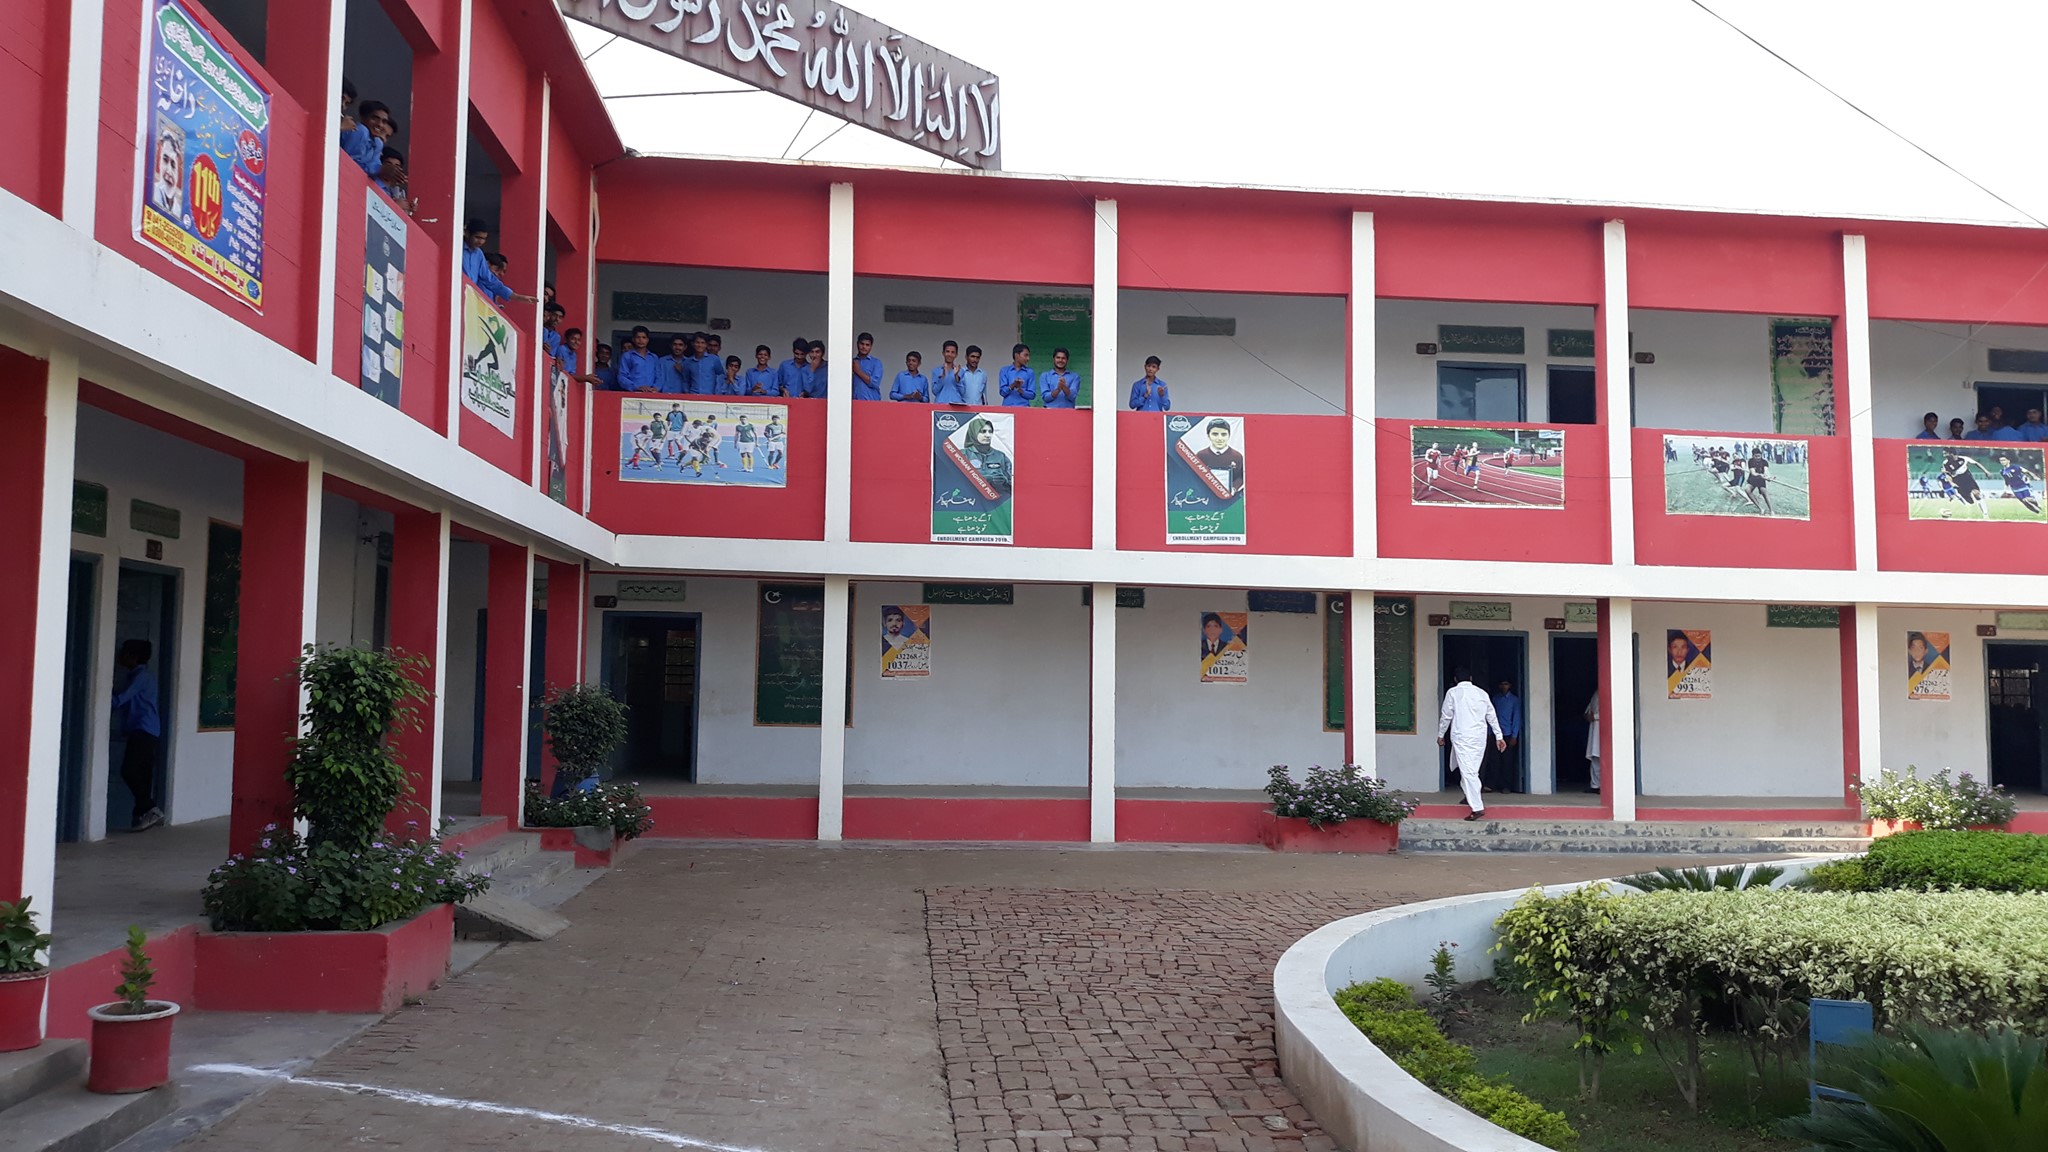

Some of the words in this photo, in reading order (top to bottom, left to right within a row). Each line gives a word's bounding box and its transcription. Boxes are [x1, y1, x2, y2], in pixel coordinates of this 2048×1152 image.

[192, 161, 221, 212] 11th
[944, 441, 956, 454] FIRST
[954, 453, 972, 472] WOMAN
[970, 470, 987, 488] FIGHTER
[984, 487, 998, 499] PILOT
[1176, 441, 1199, 465] YOUNGEST
[1198, 463, 1208, 474] APP
[1206, 472, 1230, 498] DEVELOPER
[888, 661, 908, 670] 1037
[1208, 666, 1229, 675] 1012
[1676, 684, 1694, 692] 993
[1914, 686, 1930, 694] 976
